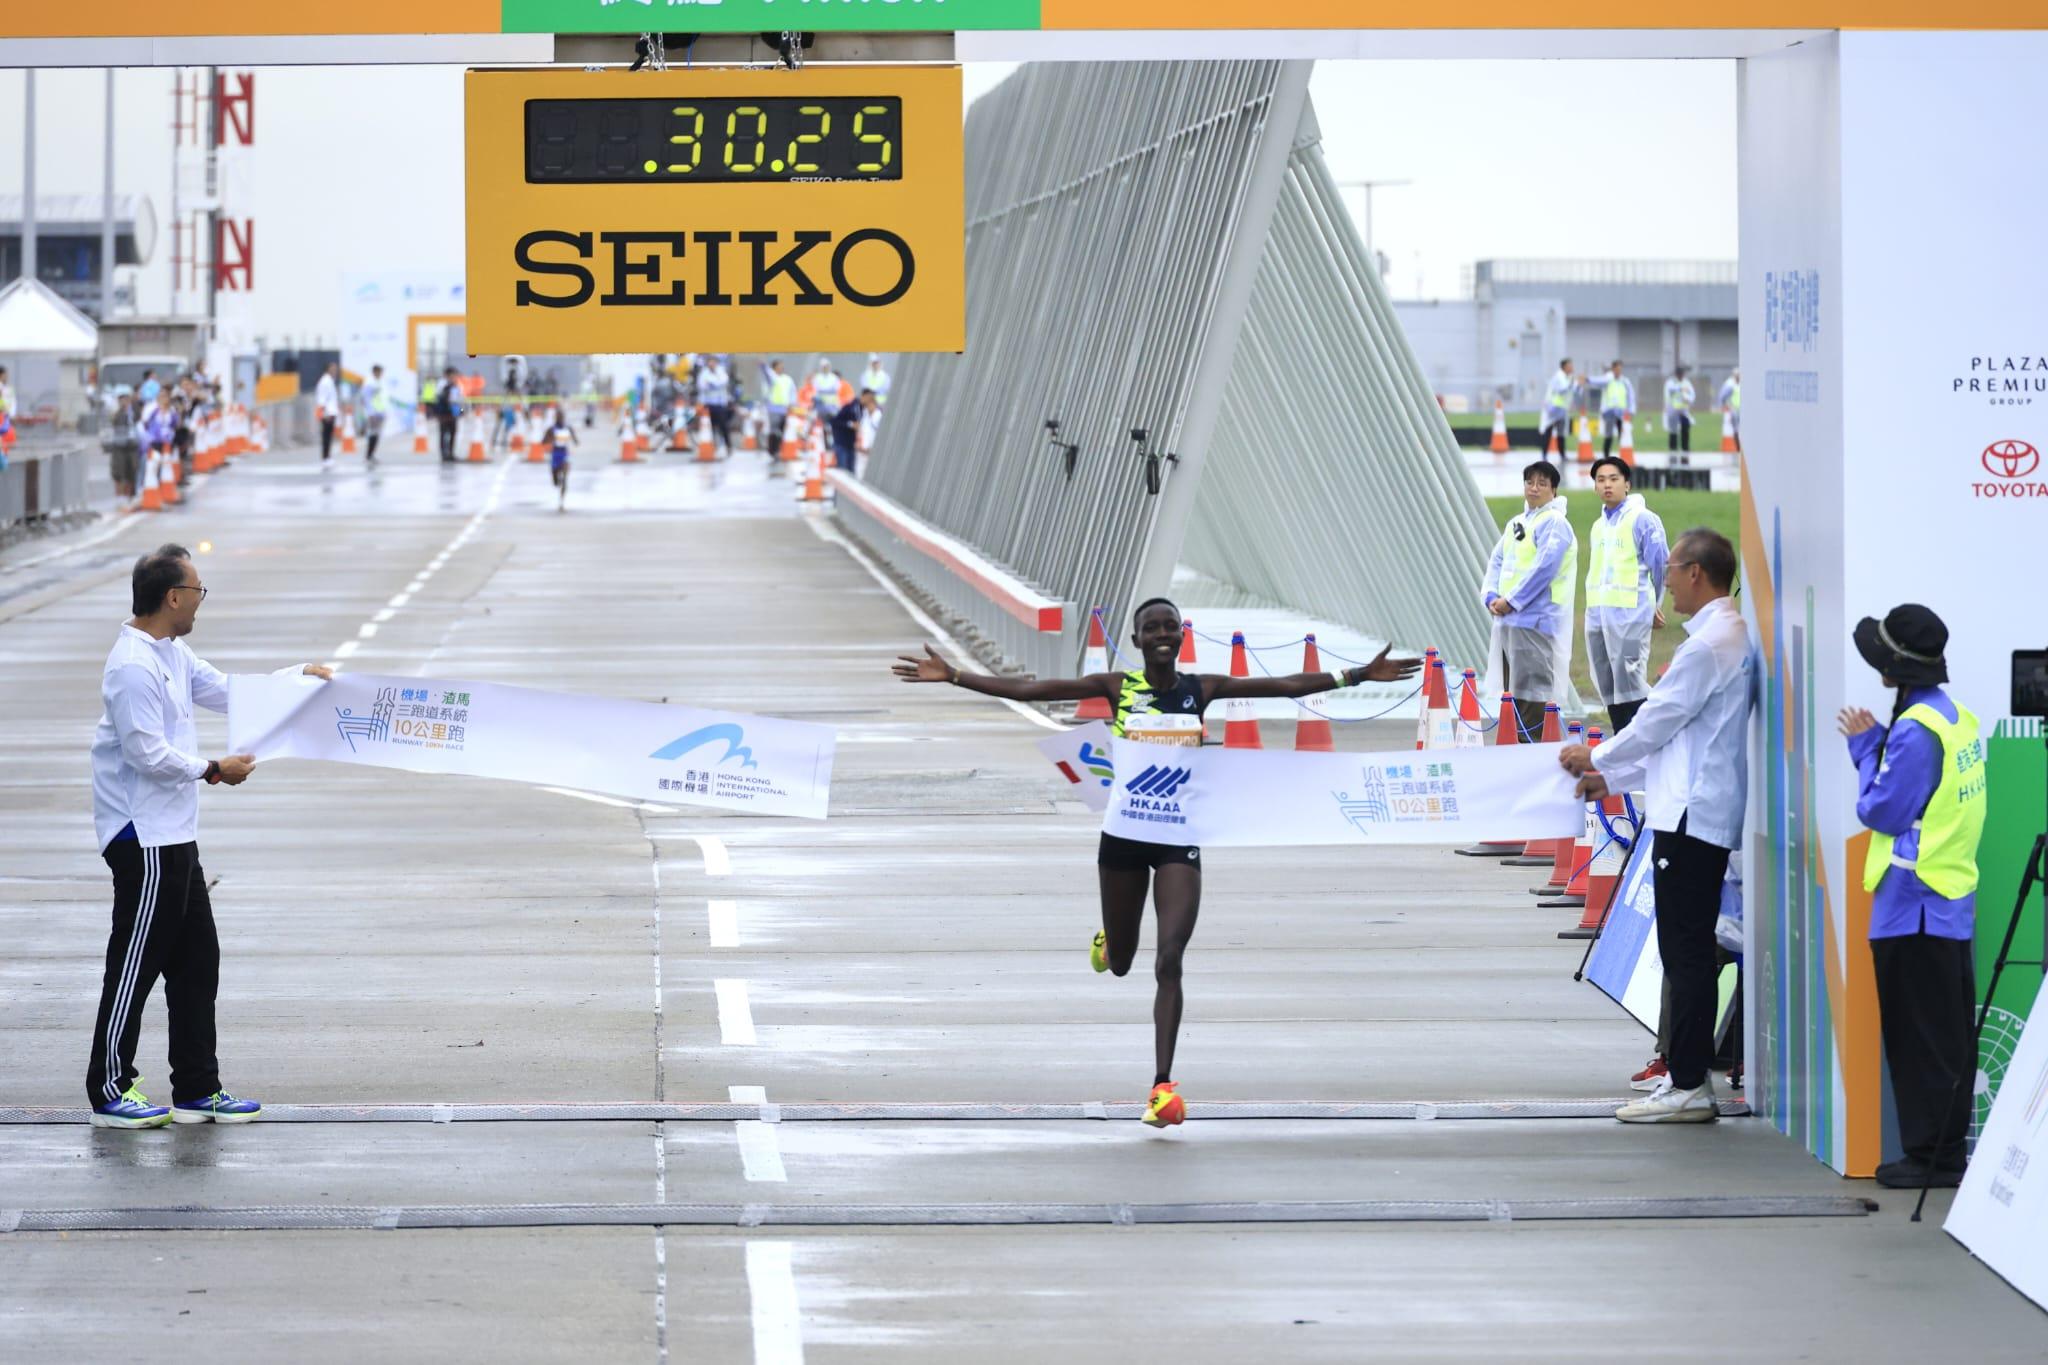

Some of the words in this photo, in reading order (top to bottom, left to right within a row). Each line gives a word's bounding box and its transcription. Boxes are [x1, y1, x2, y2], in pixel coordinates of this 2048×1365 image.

[514, 228, 915, 308] SEIKO
[1971, 357, 2048, 371] PLAZA
[1971, 483, 2048, 497] TOYOTA
[397, 704, 469, 723] 三跑道系統
[394, 719, 465, 742] 10公里跑
[392, 737, 424, 748] RUNWAY
[445, 743, 465, 751] RACE
[686, 769, 710, 782] 香港
[717, 773, 743, 782] HONG
[745, 776, 772, 786] KONG
[658, 778, 709, 794] 國際機場
[716, 781, 789, 796] INTERNATIONAL
[715, 791, 755, 800] AIRPORT
[1130, 798, 1181, 812] HKAAA
[1392, 798, 1457, 813] 10公里跑
